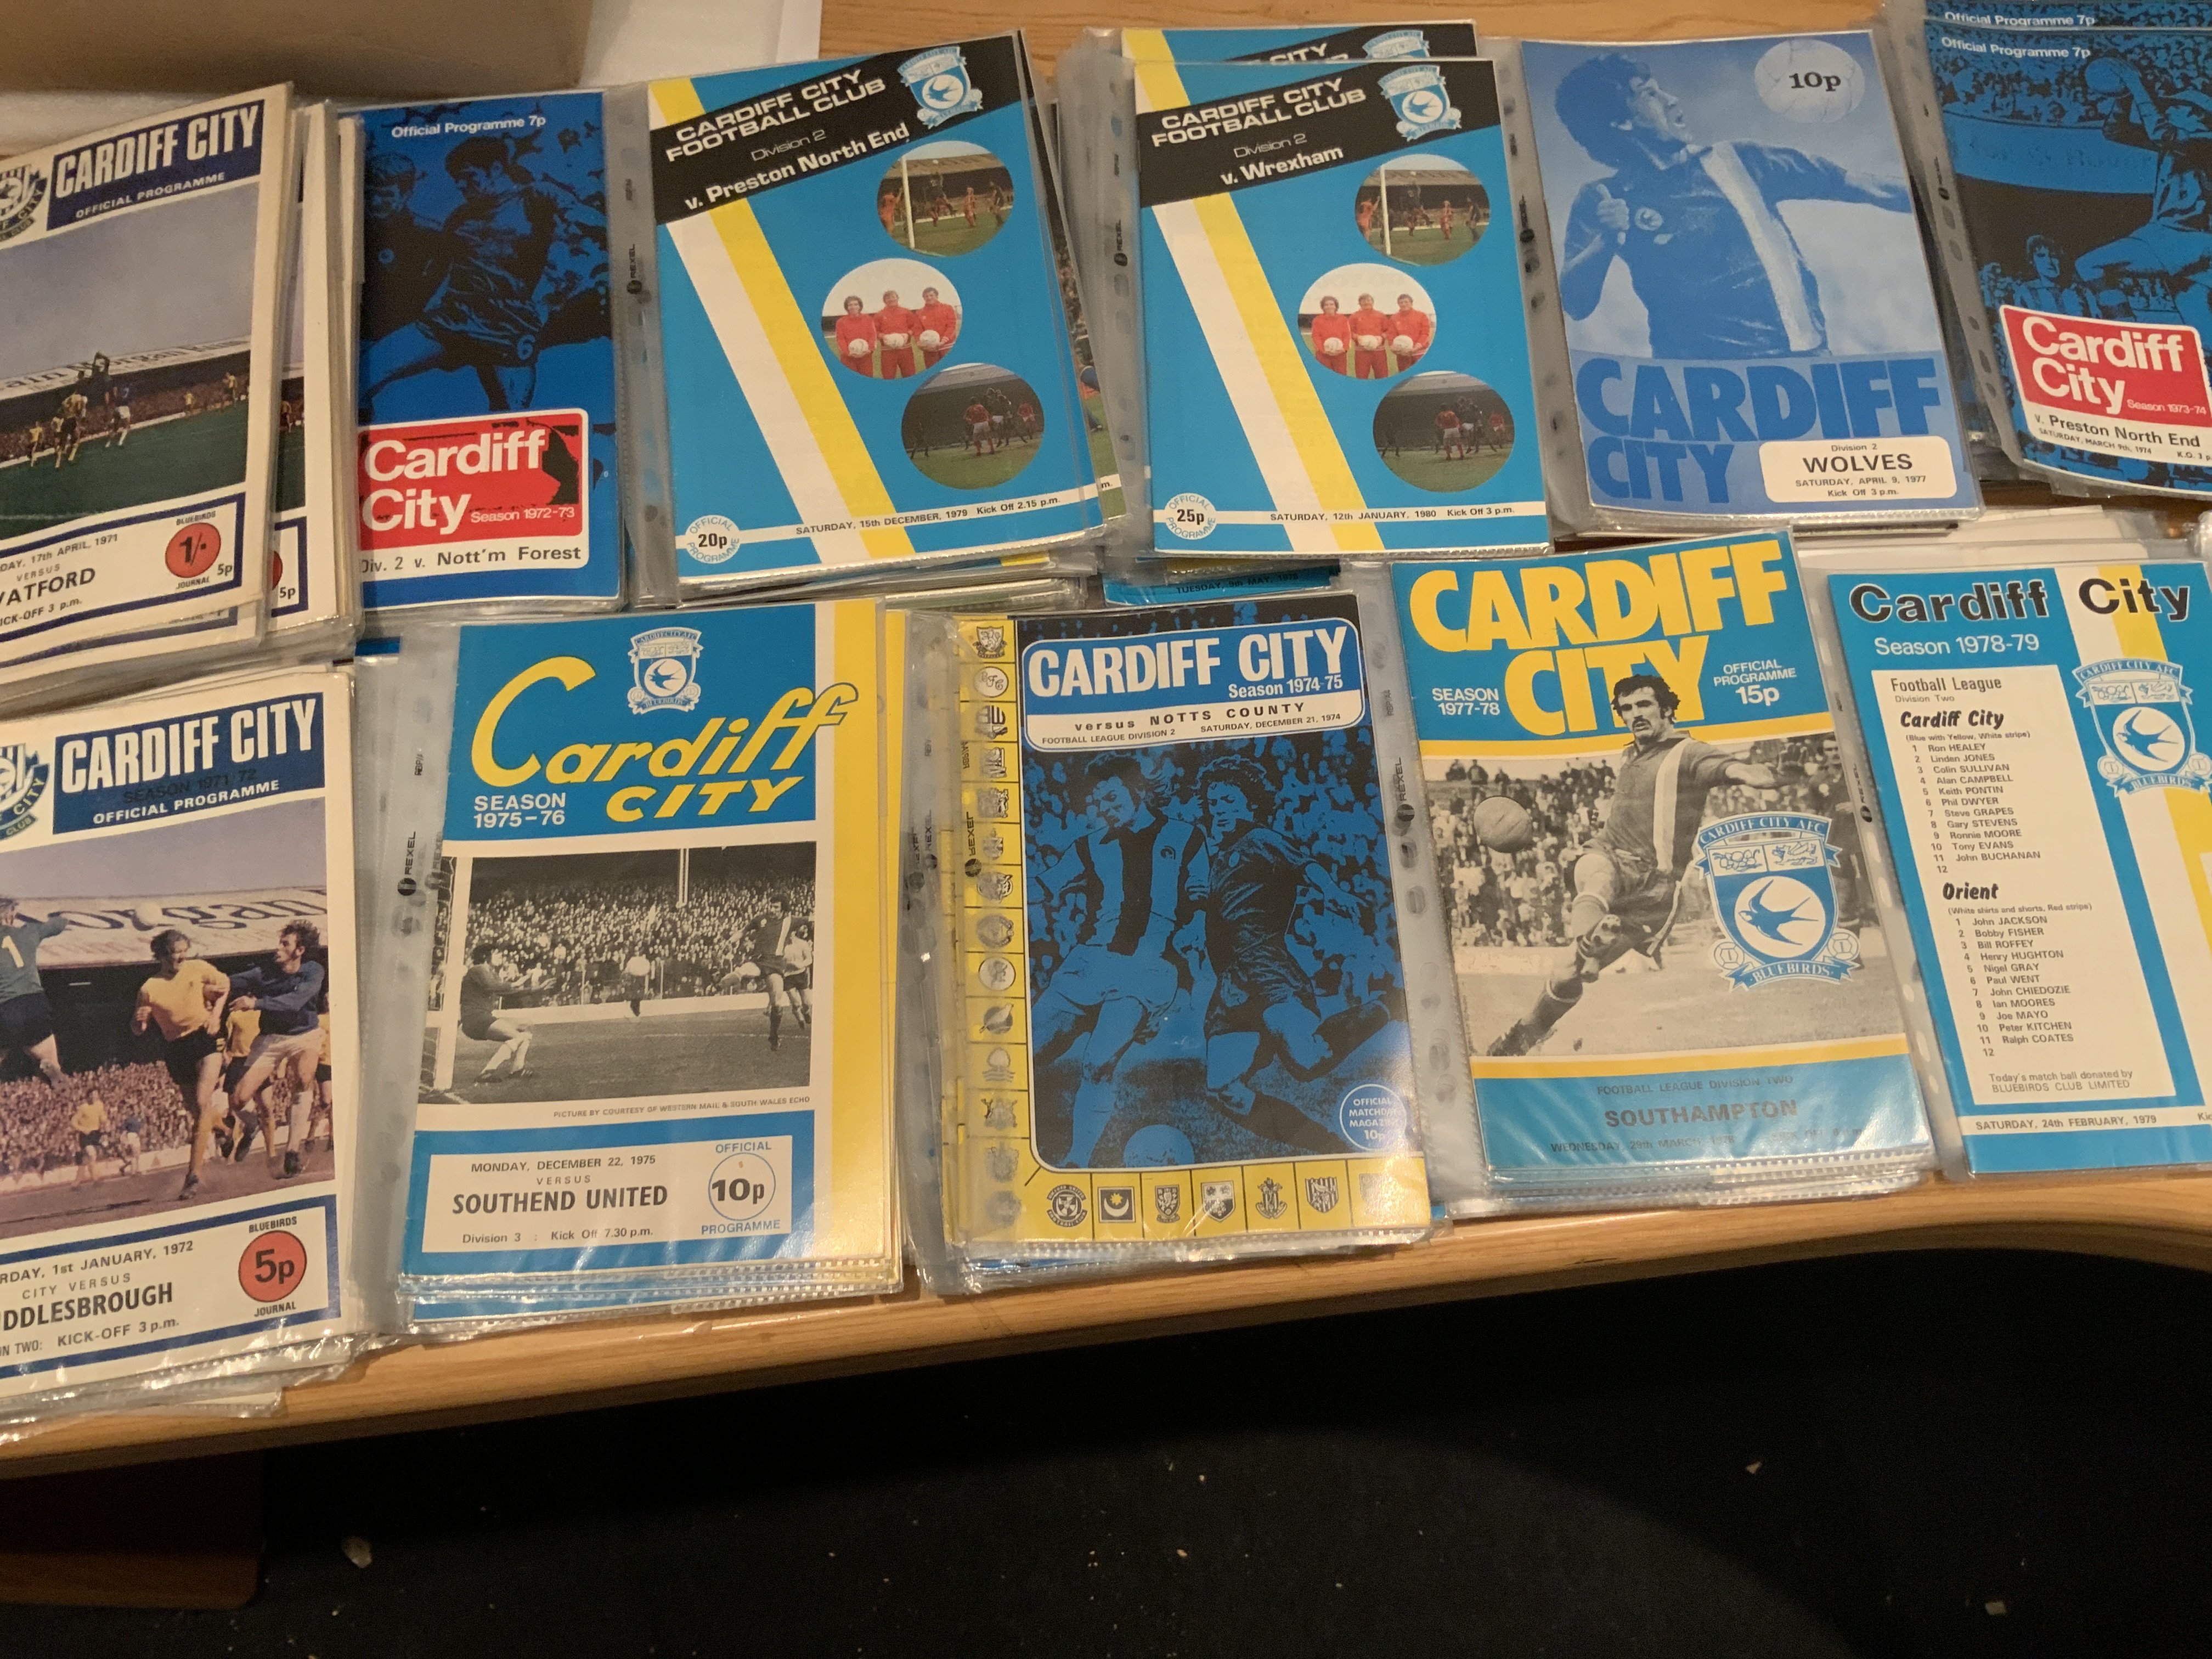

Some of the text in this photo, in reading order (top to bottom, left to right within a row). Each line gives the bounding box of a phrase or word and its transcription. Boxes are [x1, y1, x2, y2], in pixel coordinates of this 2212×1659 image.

[1941, 37, 2091, 59] Official Programme 7p
[1789, 71, 1841, 92] 10p
[676, 69, 862, 142] CARDIFF CITY
[1161, 77, 1344, 129] CARDIFF CITY
[392, 116, 546, 139] Official Programme 7p
[665, 78, 886, 162] FOOTBALL CLUB
[1152, 88, 1366, 147] FOOTBALL CLUB
[56, 105, 258, 198] CARDIFF CITY
[751, 129, 827, 162] Division 2
[1233, 133, 1307, 158] Division 2
[685, 123, 910, 211] v. Preston North End
[1220, 145, 1344, 185] v. Wrexham
[76, 171, 225, 219] OFFICIAL PROGRAMME
[2022, 316, 2183, 372] Cardiff
[2032, 357, 2125, 415] City
[1576, 358, 1941, 442] CARDIFF
[365, 429, 545, 482] Cardiff
[1803, 453, 1912, 473] WOLVES
[1588, 436, 1735, 504] CITY
[362, 489, 471, 535] City
[471, 507, 574, 524] Season 1972-73
[1176, 509, 1205, 525] 25p
[32, 552, 52, 563] 17th
[95, 534, 117, 545] 1971
[698, 533, 728, 550] 20p
[16, 564, 60, 582] VERSUS
[217, 563, 233, 578] 5p
[280, 586, 296, 600] 5p
[1409, 540, 1787, 653] CARDIFF
[1849, 577, 2191, 624] Cardiff City
[1874, 633, 2040, 656] Season 1978-79
[1028, 626, 1348, 698] CARDIFF CITY
[1723, 659, 1782, 675] OFFICIAL
[1713, 667, 1797, 687] PROGRAMME
[1891, 677, 2002, 692] Football League
[1432, 687, 1499, 702] SEASON
[1735, 684, 1780, 707] 15p
[471, 656, 859, 787] Cardiff
[1075, 702, 1306, 731] versus NOTTS COUNTY
[1438, 702, 1501, 716] 1977-78
[1900, 709, 2004, 730] Cardiff City
[1042, 736, 1088, 744] FOOTBALL
[1090, 733, 1125, 743] LEAGUE
[1128, 731, 1167, 741] DIVISION
[1200, 723, 1252, 733] SATURDAY,
[1255, 718, 1303, 729] DECEMBER
[1306, 716, 1319, 724] 21,
[1322, 713, 1341, 721] 1974
[61, 698, 317, 794] CARDIFF CITY
[1395, 757, 1407, 801] REXEL
[1960, 764, 2010, 772] SULLIVAN
[93, 780, 280, 825] OFFICIAL PROGRAMME
[474, 792, 567, 812] SEASON
[606, 776, 805, 822] CITY
[1700, 816, 1826, 844] CARDIFF CITY AFC
[404, 831, 416, 875] REXEL
[1943, 882, 1999, 900] Orient
[1752, 961, 1830, 982] BLUEBIRDS
[1990, 988, 2013, 997] John
[2016, 985, 2071, 995] CHIEDOZIE
[1597, 1082, 1654, 1096] FOOTBALL
[1658, 1080, 1703, 1093] LEAGUE
[1709, 1077, 1760, 1090] DIVISION
[1989, 1069, 2133, 1083] Today's match ball donated by
[1992, 1080, 2130, 1093] BLUEBIRDS CLUB LIMITED
[603, 1107, 644, 1115] COURTESY
[659, 1103, 697, 1112] WESTERN
[730, 1100, 757, 1108] SOUTH
[760, 1097, 787, 1105] WALES
[1605, 1099, 1798, 1129] SOUTHAMPTON
[715, 1141, 772, 1154] OFFICIAL
[471, 1155, 656, 1173] MONDAY, DECEMBER 22, 1975
[536, 1175, 591, 1186] VERSUS
[711, 1177, 765, 1204] 10p
[452, 1185, 668, 1215] SOUTHEND UNITED
[249, 1216, 297, 1234] BLUEBIRDS
[462, 1227, 653, 1244] Division 3 Kick Off 7.30 p.m.
[701, 1219, 781, 1235] PROGRAMME
[255, 1249, 295, 1284] 5p
[22, 1273, 131, 1300] CITY VERSUS
[254, 1301, 296, 1317] JOURNAL
[14, 1317, 179, 1355] TWO: KICK-OFF 3 p.m.
